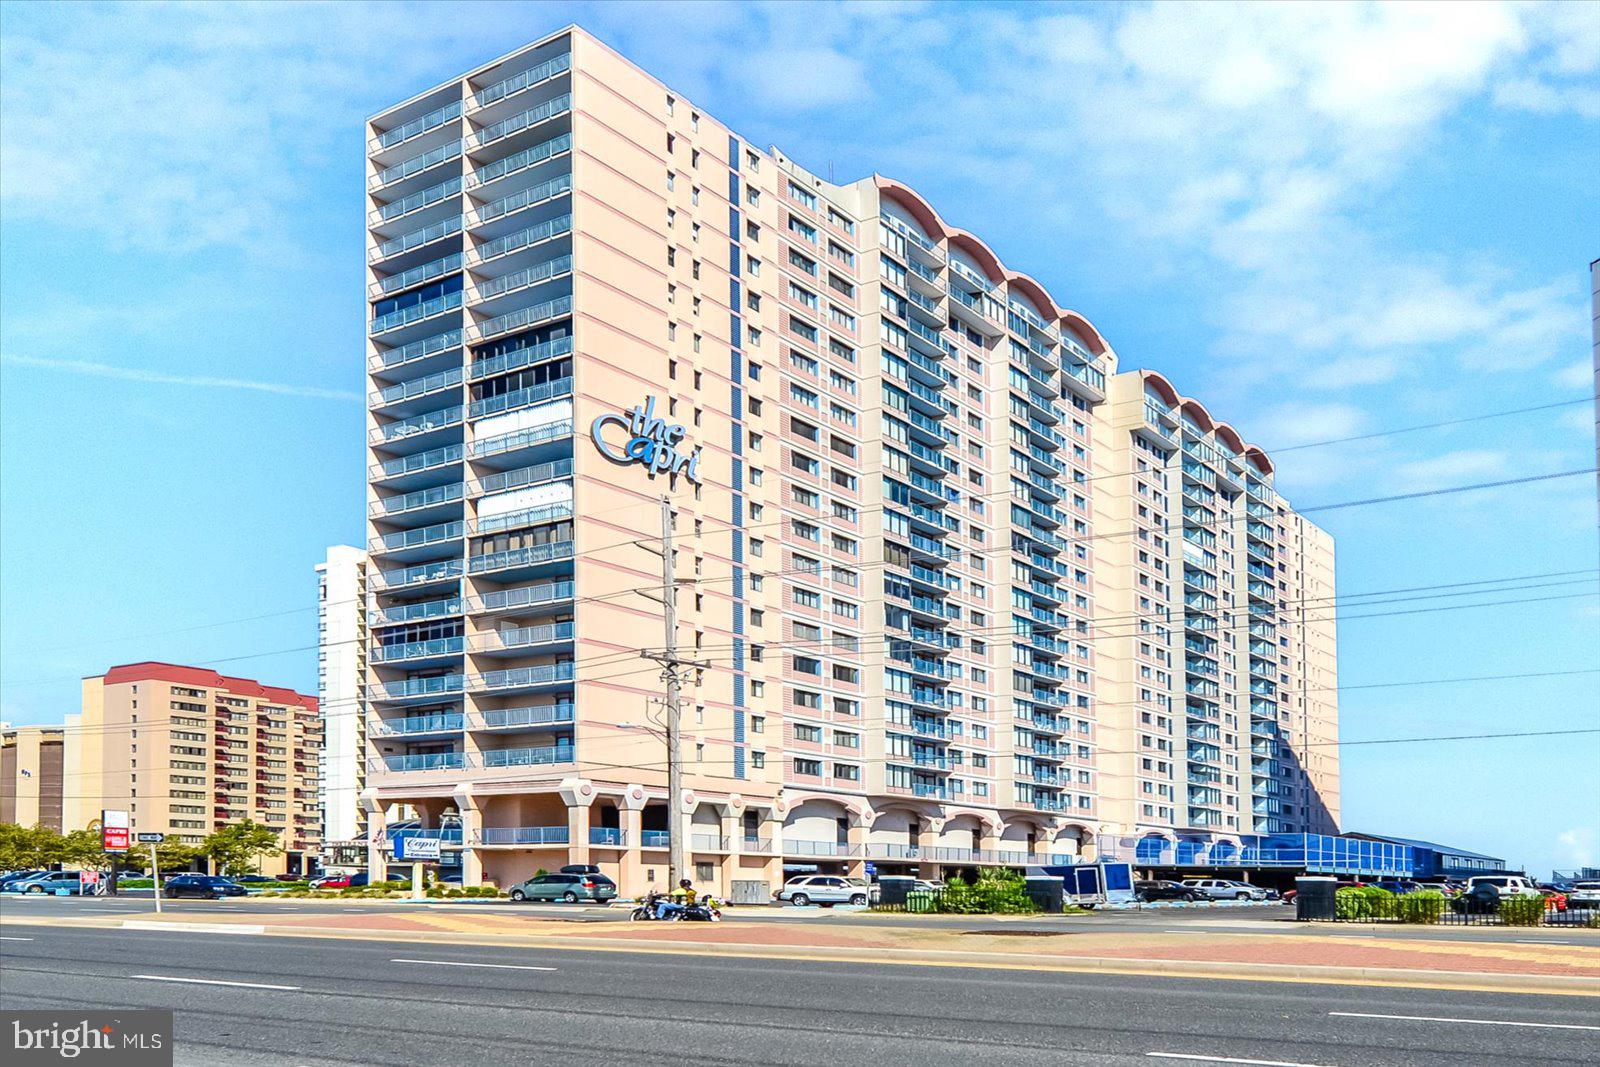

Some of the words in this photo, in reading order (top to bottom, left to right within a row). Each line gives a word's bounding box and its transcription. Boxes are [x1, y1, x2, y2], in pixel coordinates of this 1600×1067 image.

[625, 395, 686, 446] the
[590, 413, 702, 483] Capri
[405, 839, 438, 849] Capri
